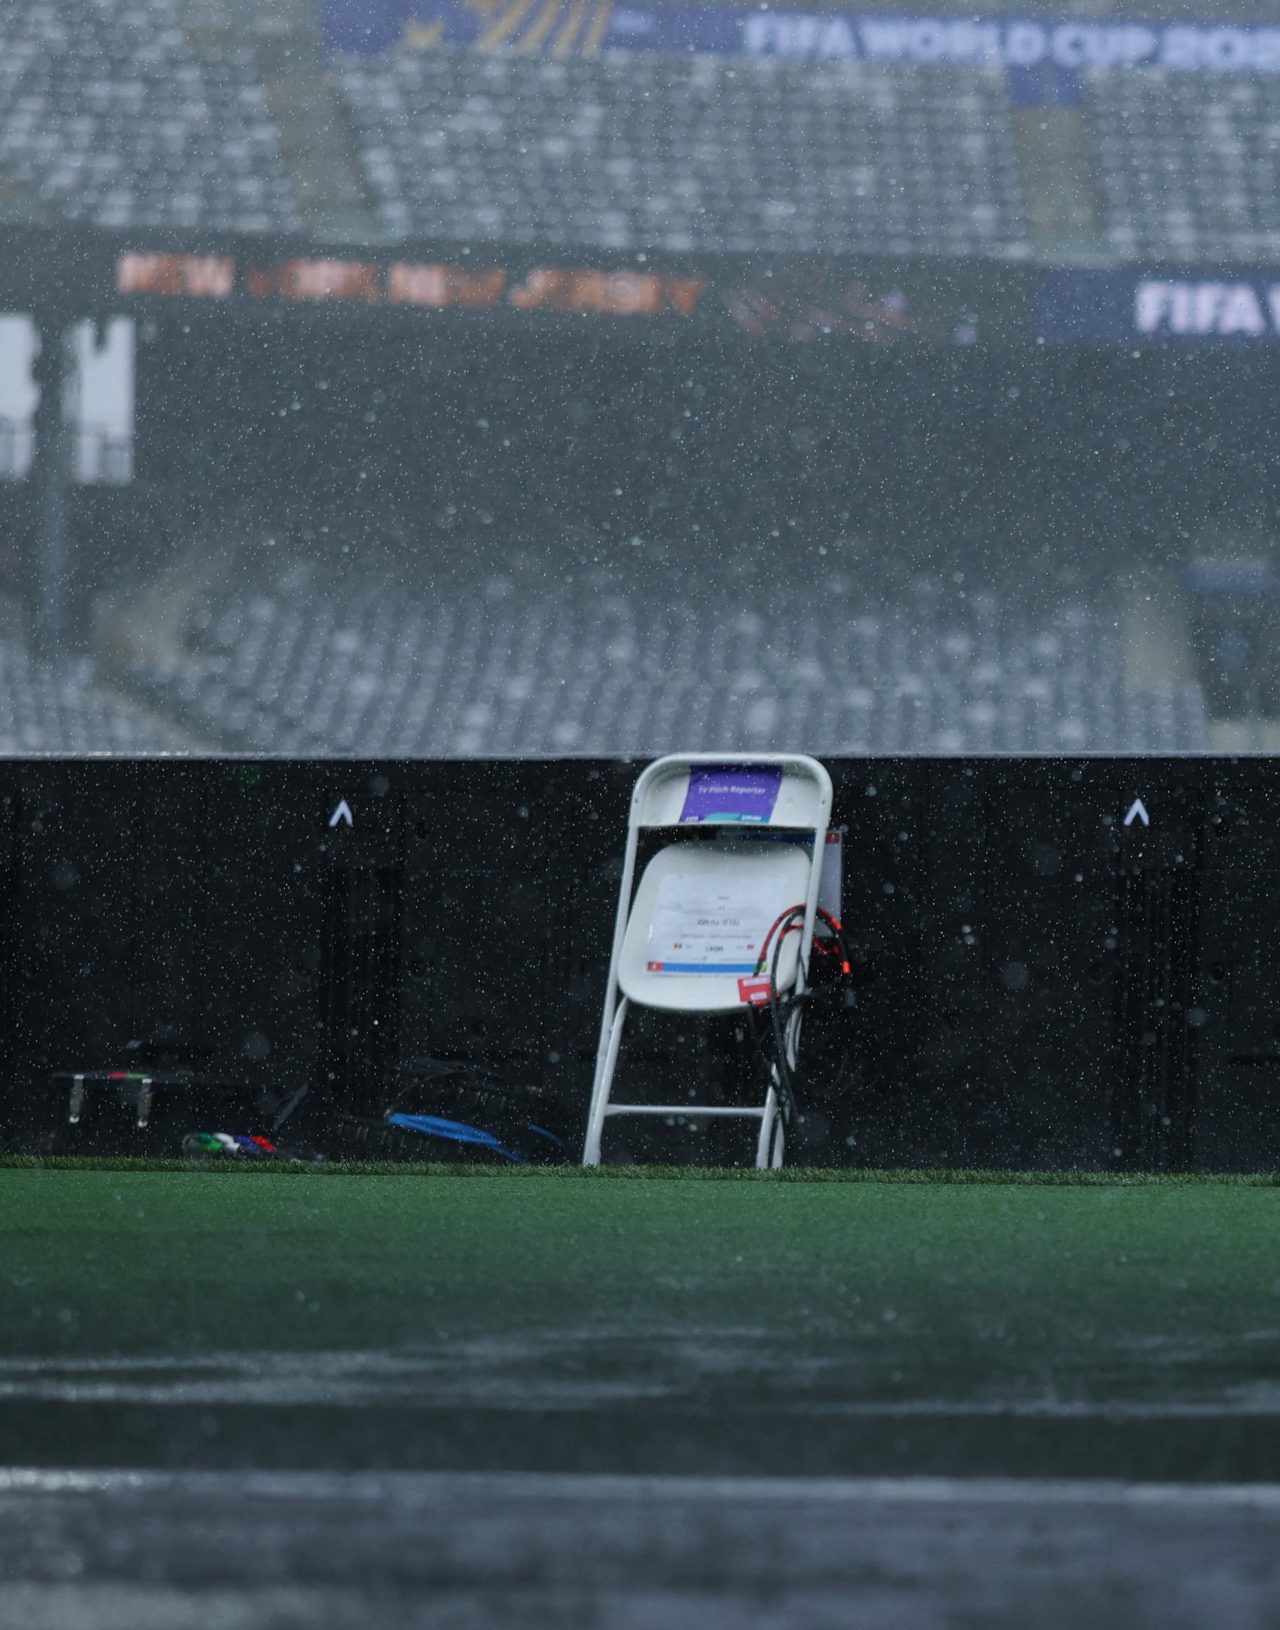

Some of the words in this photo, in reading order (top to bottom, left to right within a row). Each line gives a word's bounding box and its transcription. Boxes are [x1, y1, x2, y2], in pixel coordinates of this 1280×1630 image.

[744, 14, 854, 58] FIFA
[860, 20, 1046, 66] WORLD
[1052, 24, 1160, 68] CUP
[1134, 281, 1266, 336] FIFA
